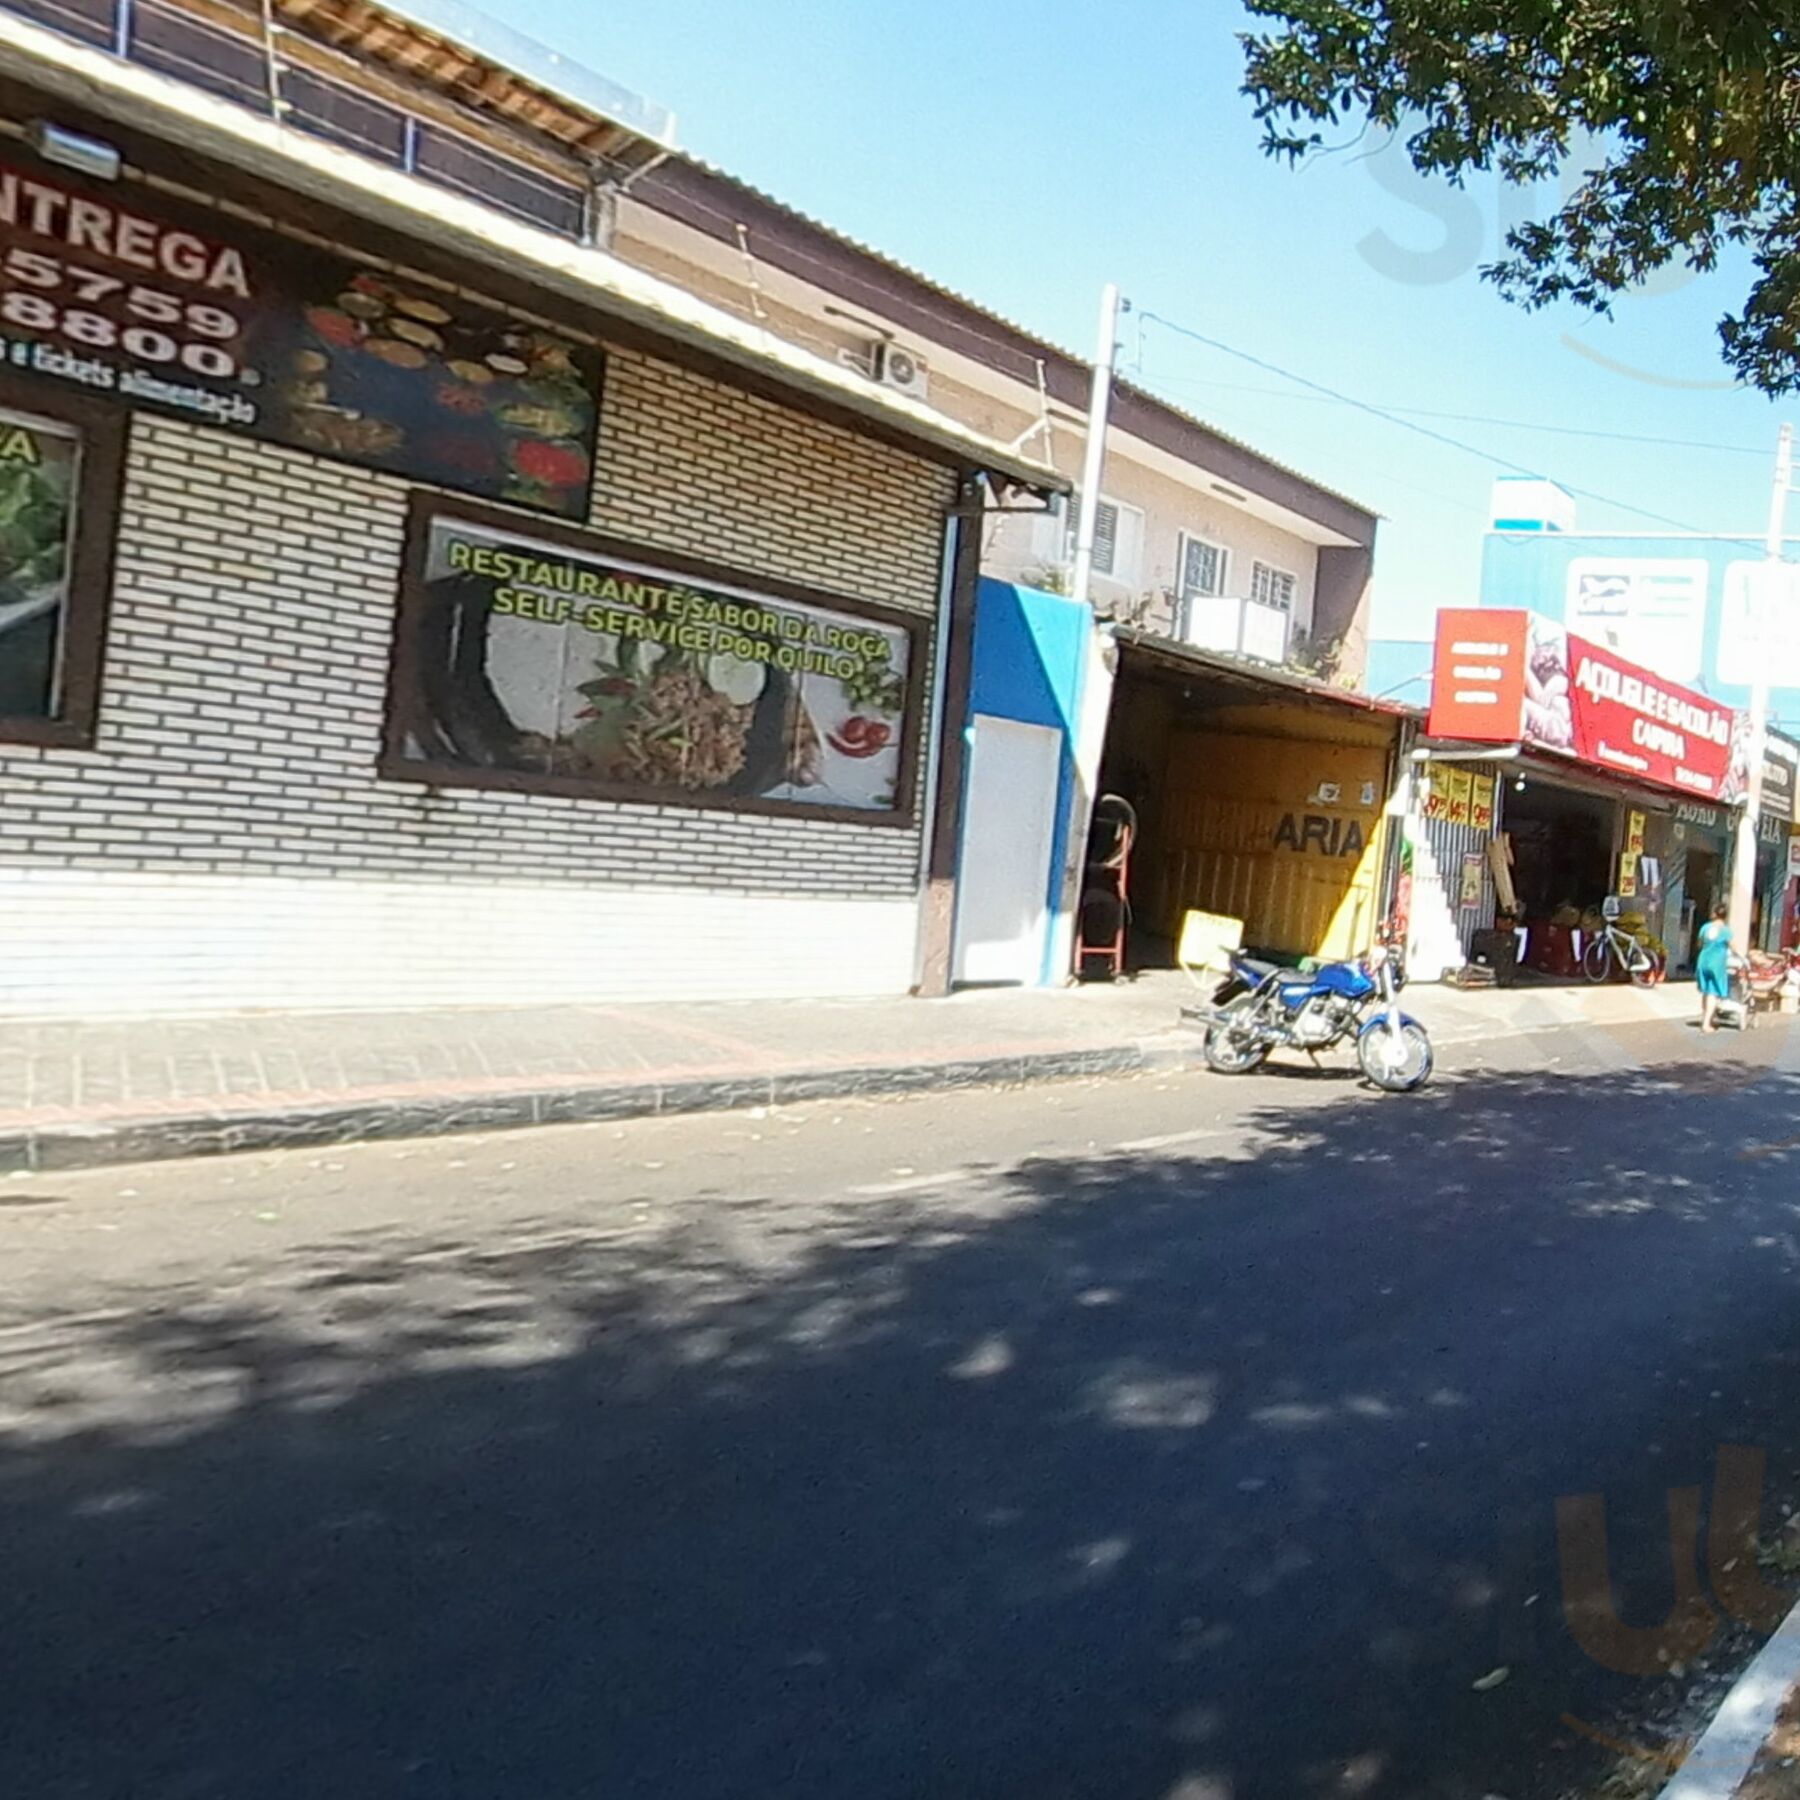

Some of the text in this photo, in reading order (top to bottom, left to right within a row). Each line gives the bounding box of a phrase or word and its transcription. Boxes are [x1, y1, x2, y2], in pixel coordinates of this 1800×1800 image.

[4, 248, 239, 339] 5759
[33, 344, 115, 389] tickets
[119, 368, 256, 425] alimentação
[450, 542, 890, 660] RESTAURANTE SABOR DA ROÇA
[493, 587, 854, 680] SELF-SERVICE POR QUILO
[1273, 812, 1363, 858] ARIA
